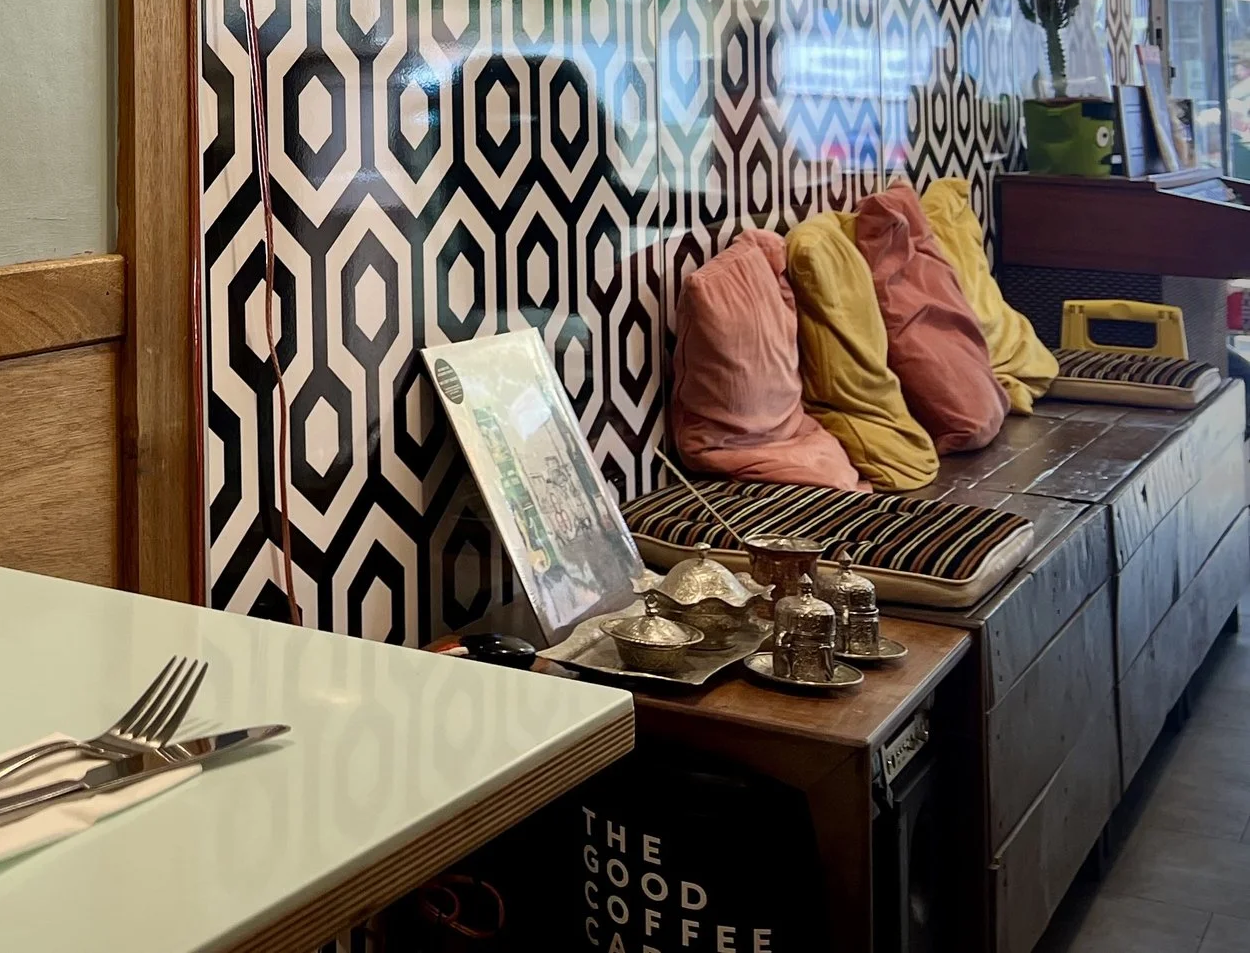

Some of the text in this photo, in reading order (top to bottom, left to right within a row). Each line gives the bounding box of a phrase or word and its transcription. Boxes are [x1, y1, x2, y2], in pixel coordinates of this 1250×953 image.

[582, 806, 662, 866] THE
[583, 844, 708, 911] GOOD
[584, 880, 773, 953] COFFEE
[584, 915, 662, 953] CA
